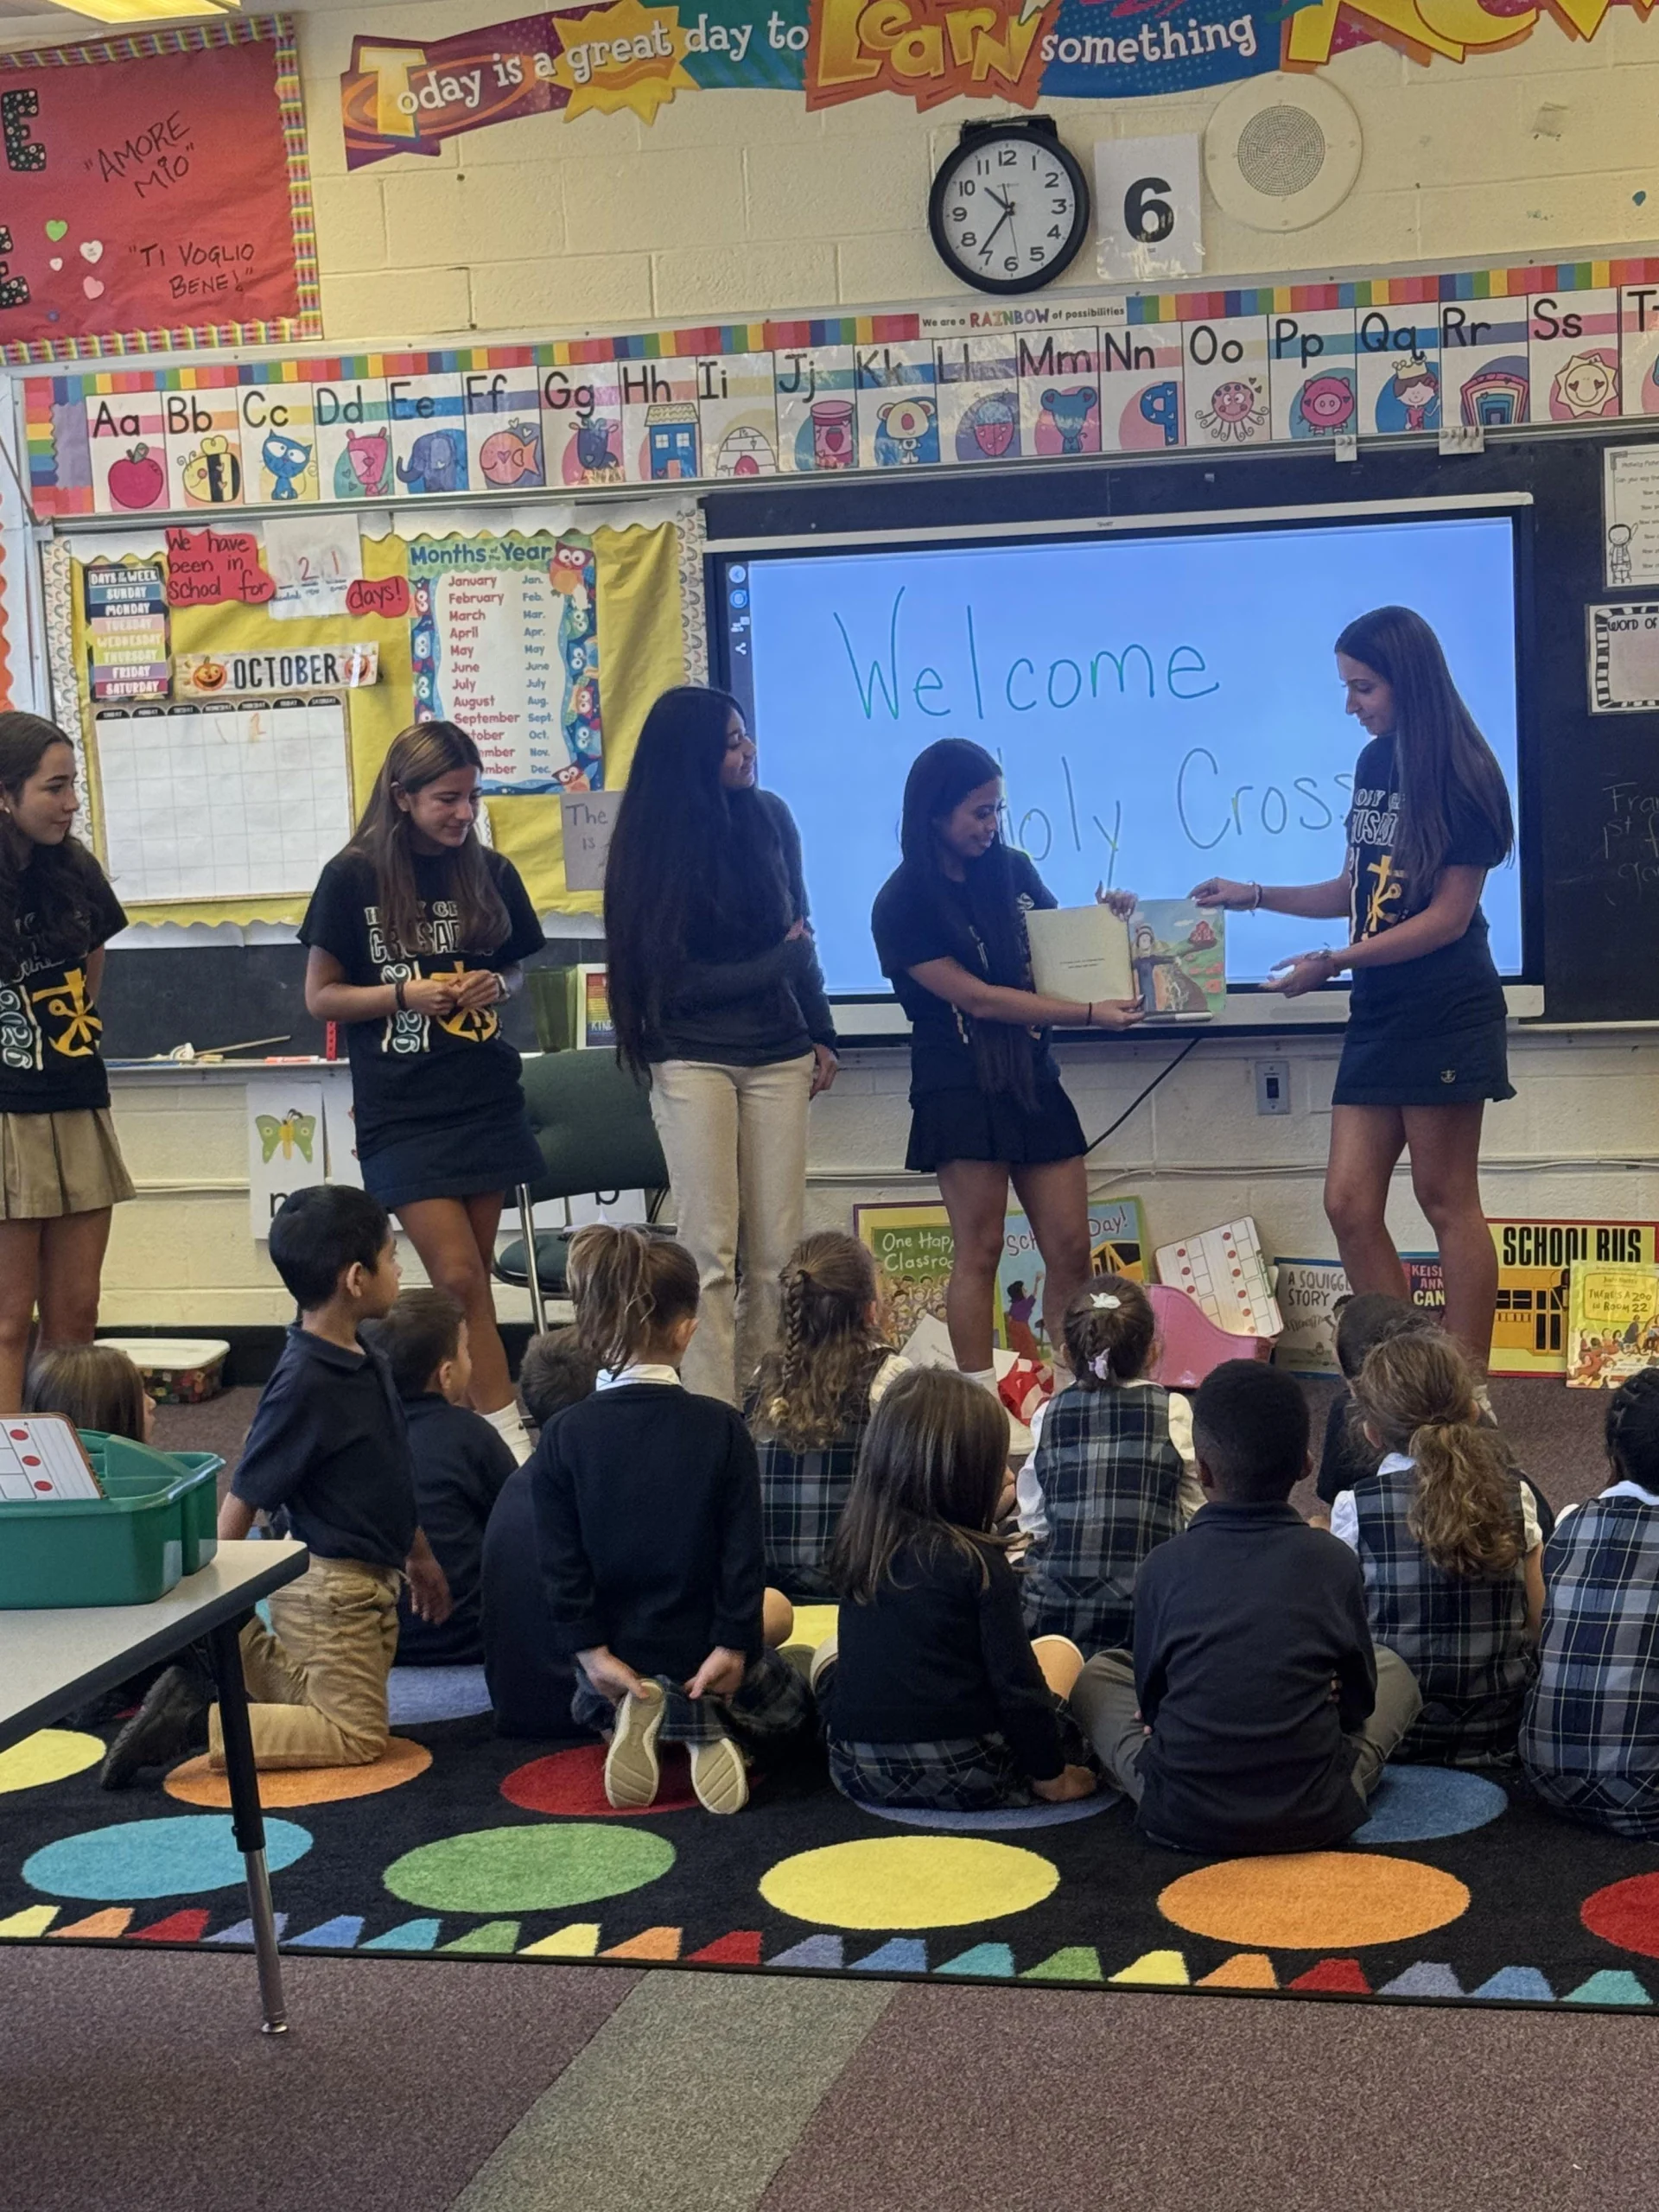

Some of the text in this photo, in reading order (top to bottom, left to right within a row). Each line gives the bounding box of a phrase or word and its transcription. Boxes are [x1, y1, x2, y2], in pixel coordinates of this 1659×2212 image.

[359, 47, 480, 138] Today
[493, 53, 524, 87] is
[534, 52, 555, 77] a
[566, 19, 673, 83] great
[684, 14, 751, 61] day
[767, 11, 809, 51] to
[1040, 15, 1257, 64] something
[999, 150, 1017, 166] 12
[977, 159, 989, 175] 11
[1045, 172, 1059, 188] 2
[959, 180, 976, 197] 10
[1051, 199, 1067, 214] 3
[1124, 176, 1174, 243] 6
[952, 207, 967, 222] 9
[1046, 224, 1061, 239] 4
[961, 232, 977, 247] 8
[179, 242, 255, 267] VOGLIO
[980, 250, 994, 266] 7
[1029, 246, 1045, 262] 5
[1004, 257, 1019, 271] 6
[922, 318, 938, 327] We
[969, 308, 1049, 327] RAINBOW
[1052, 310, 1063, 320] of
[1065, 308, 1125, 321] possibilities
[93, 401, 141, 439] Aa
[167, 397, 213, 435] Bb
[243, 391, 289, 429] Cc
[316, 386, 363, 426] Dd
[390, 381, 435, 421] Ee
[467, 374, 507, 415] Ff
[543, 371, 595, 419] Gg
[622, 365, 672, 405] Hh
[779, 353, 816, 404] Jj
[1019, 336, 1093, 378] Mm
[1104, 331, 1155, 372] Nn
[1189, 325, 1244, 365] Oo
[1275, 318, 1325, 369] Pp
[1360, 312, 1426, 361] Qq
[1441, 307, 1492, 349] Rr
[1533, 298, 1583, 341] Ss
[1627, 289, 1659, 333] T
[165, 529, 250, 552] We have
[410, 543, 486, 565] Months
[499, 543, 552, 562] Year
[168, 555, 244, 574] been in
[91, 572, 117, 585] DAYS
[127, 570, 157, 582] WEEK
[238, 569, 268, 600] for
[448, 575, 543, 588] January Jan.
[106, 587, 147, 601] SUNDAY
[350, 576, 403, 610] days!
[448, 592, 544, 606] February Feb.
[105, 603, 150, 616] MONDAY
[449, 610, 546, 621] March Mar.
[105, 619, 152, 632] TUESDAY
[449, 626, 546, 640] April Apr.
[97, 634, 162, 647] WEDNESDAY
[103, 649, 158, 664] THURSDAY
[450, 645, 544, 658] May May
[834, 586, 1219, 719] Welcome
[112, 666, 151, 679] FRIDAY
[233, 653, 340, 689] OCTOBER
[451, 662, 550, 673] June June
[105, 681, 159, 695] SATURDAY
[452, 677, 546, 691] July July
[453, 695, 549, 709] August Aug.
[454, 712, 554, 727] September Sept.
[468, 728, 550, 741] tober Oct.
[480, 747, 550, 758] mber Nov.
[482, 764, 551, 774] mber Dec.
[565, 803, 608, 826] The
[381, 963, 422, 1053] 226
[1088, 1205, 1128, 1237] Day!
[882, 1231, 954, 1253] One Hap
[1503, 1227, 1641, 1266] SCHOOL BUS
[885, 1252, 954, 1272] Classroo
[1412, 1264, 1442, 1277] KEIS
[1287, 1270, 1352, 1291] A SQUIGGL
[1288, 1288, 1330, 1306] STORY
[1413, 1290, 1446, 1306] CAN
[1604, 1301, 1630, 1313] ROOM
[1631, 1303, 1648, 1313] 22
